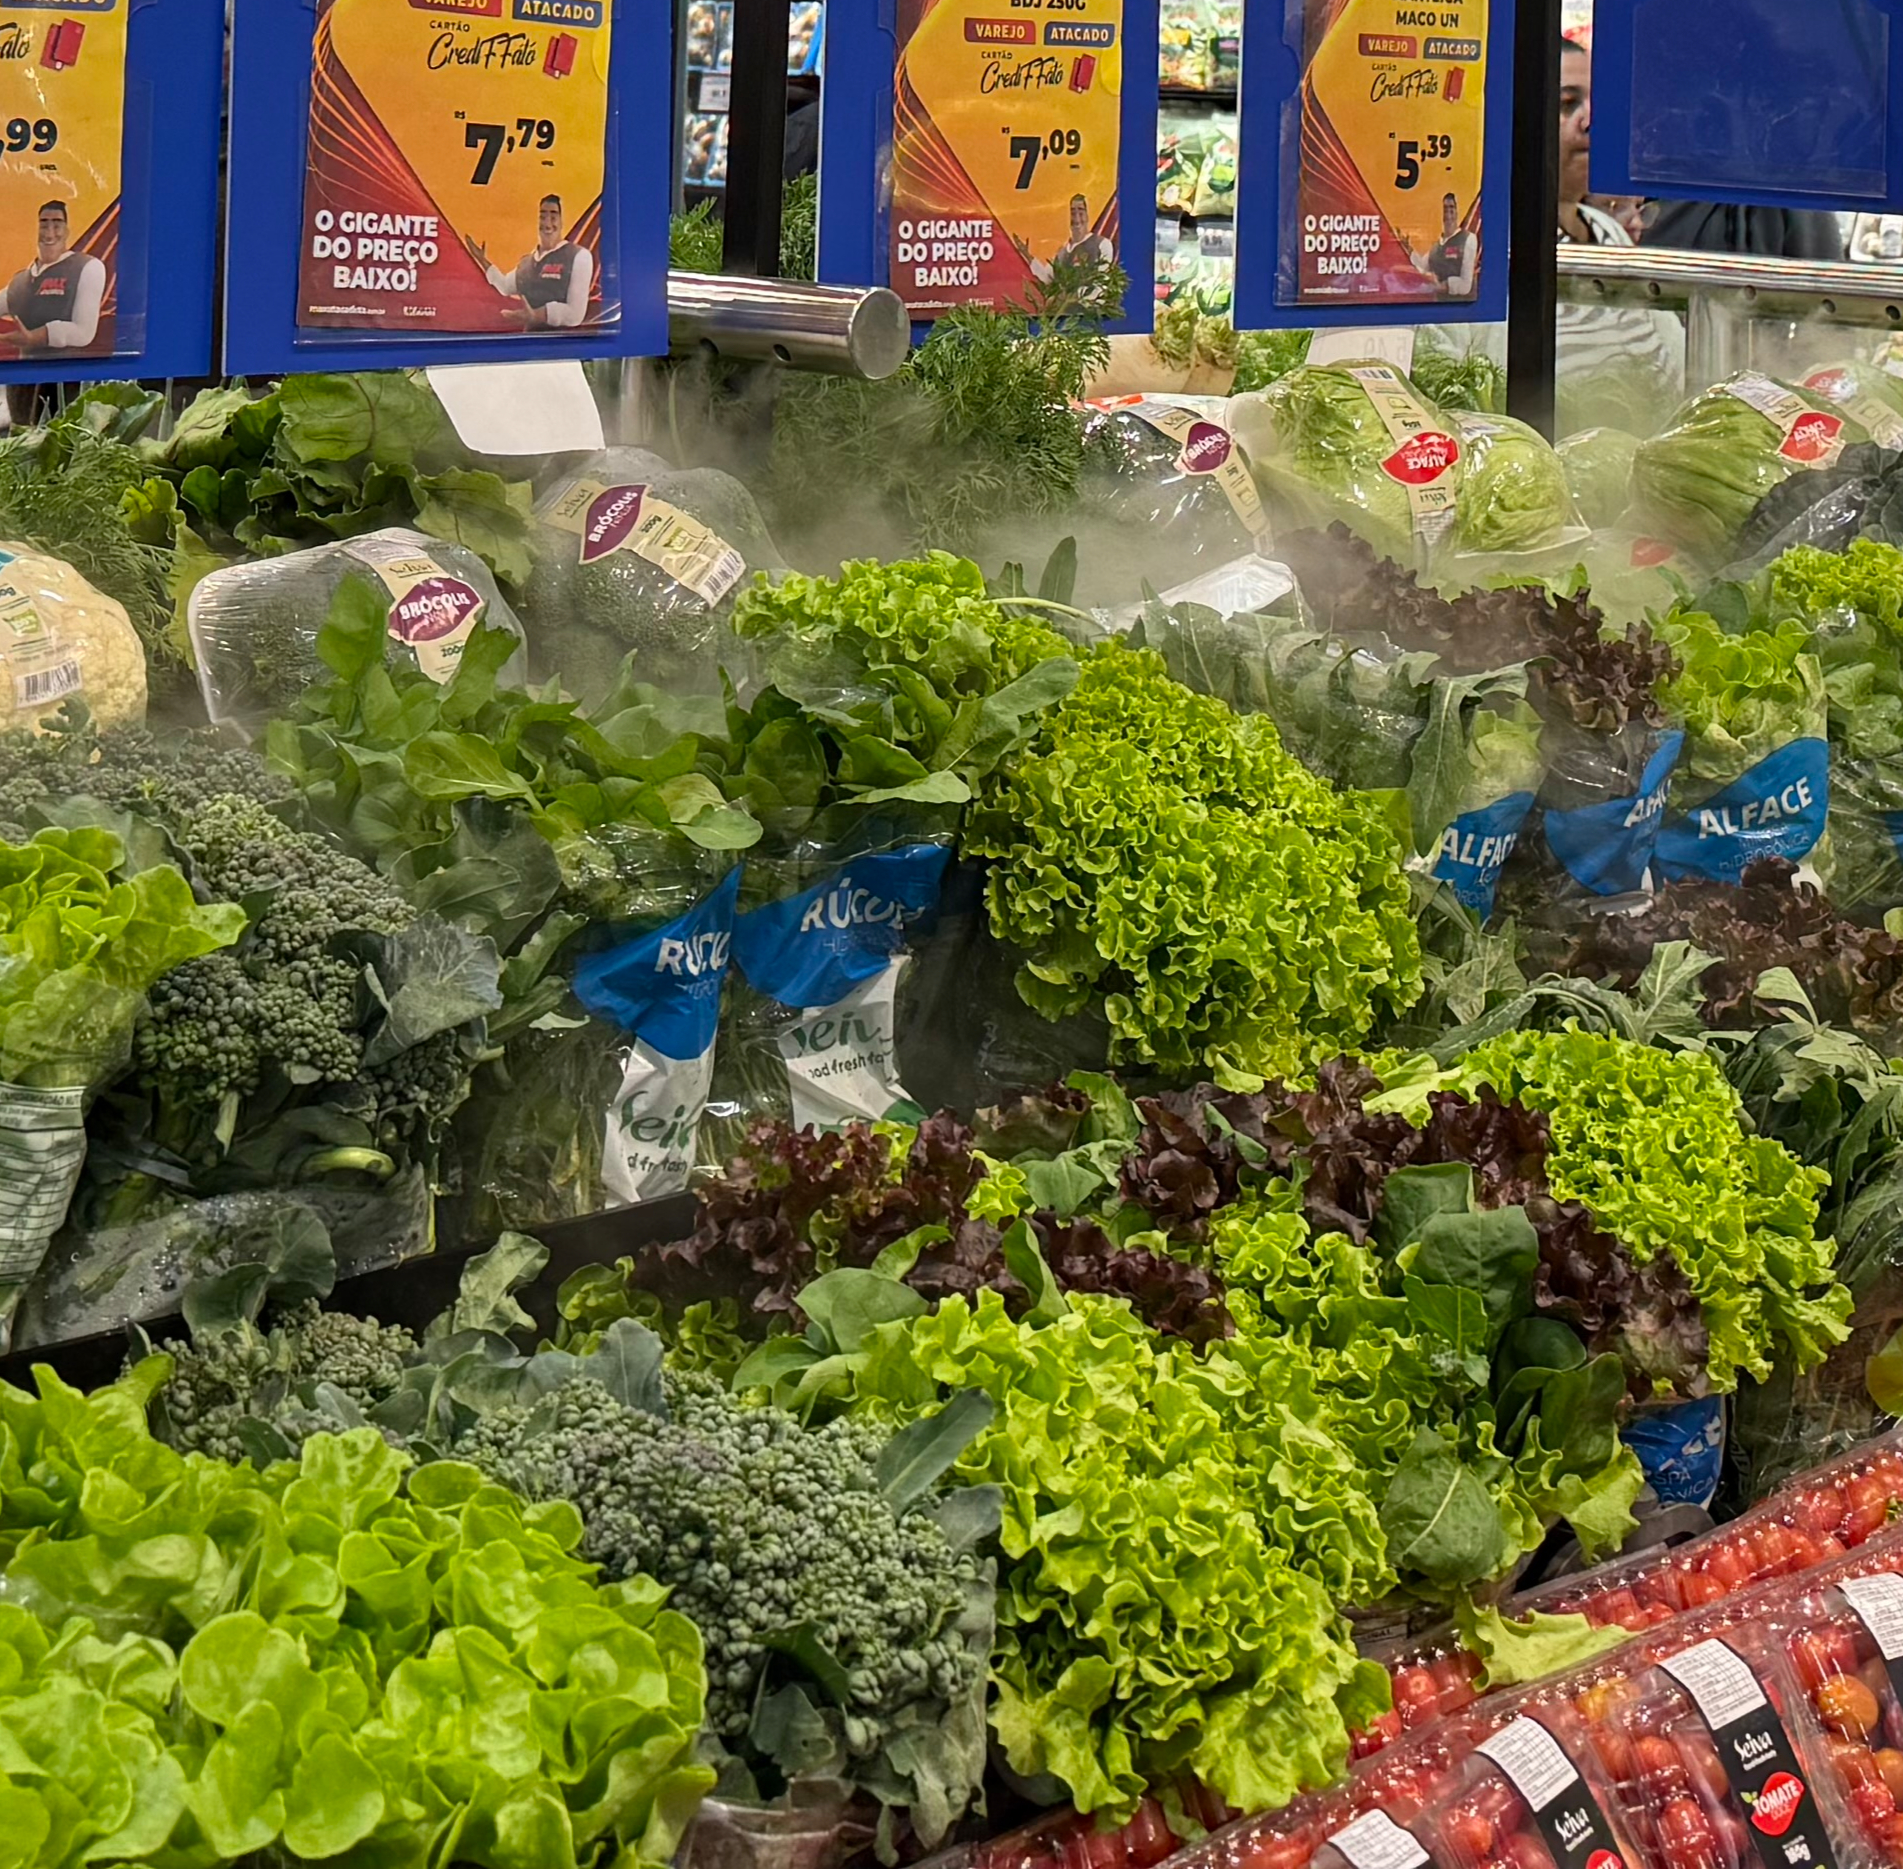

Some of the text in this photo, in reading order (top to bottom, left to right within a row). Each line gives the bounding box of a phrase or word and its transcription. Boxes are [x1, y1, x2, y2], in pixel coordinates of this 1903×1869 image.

[521, 0, 596, 22] ATACADO
[1396, 10, 1459, 28] MACO UN
[429, 20, 470, 32] CARTÃO
[975, 23, 1110, 43] VAREJO ATACADO
[1367, 38, 1477, 57] VAREJO ATACADO
[464, 118, 555, 186] 7,79
[1009, 129, 1082, 190] 7,09
[1395, 134, 1452, 190] 5,39
[339, 211, 439, 238] GIGANTE
[917, 219, 993, 240] GIGANTE
[1319, 215, 1380, 233] GIGANTE
[313, 236, 439, 269] DO PREÇO
[898, 242, 994, 266] DO PREÇO
[1330, 234, 1380, 257] PREÇO
[915, 265, 979, 288] BAIXO!
[1317, 256, 1368, 275] BAIXO!
[333, 265, 418, 292] BAIXO!
[1698, 776, 1813, 840] ALFACE
[1752, 1780, 1801, 1818] TOMATE
